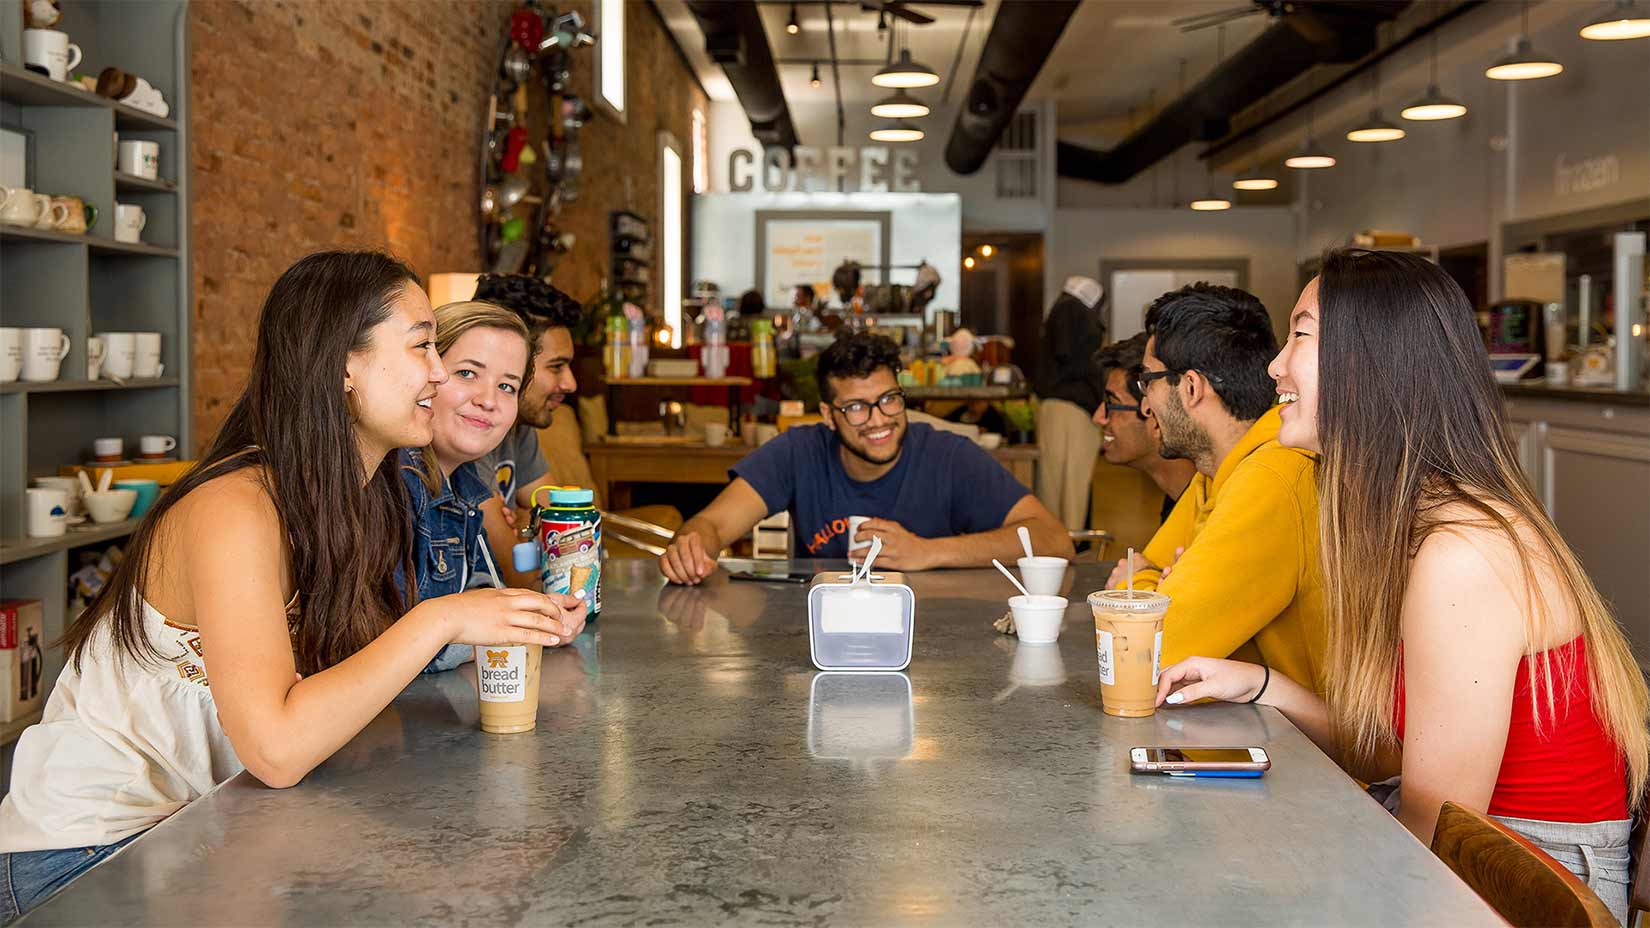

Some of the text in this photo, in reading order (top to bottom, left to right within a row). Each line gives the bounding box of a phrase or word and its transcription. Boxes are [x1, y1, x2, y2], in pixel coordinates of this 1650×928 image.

[729, 145, 922, 192] COFFEE
[481, 665, 518, 680] bread
[481, 680, 520, 694] butter
